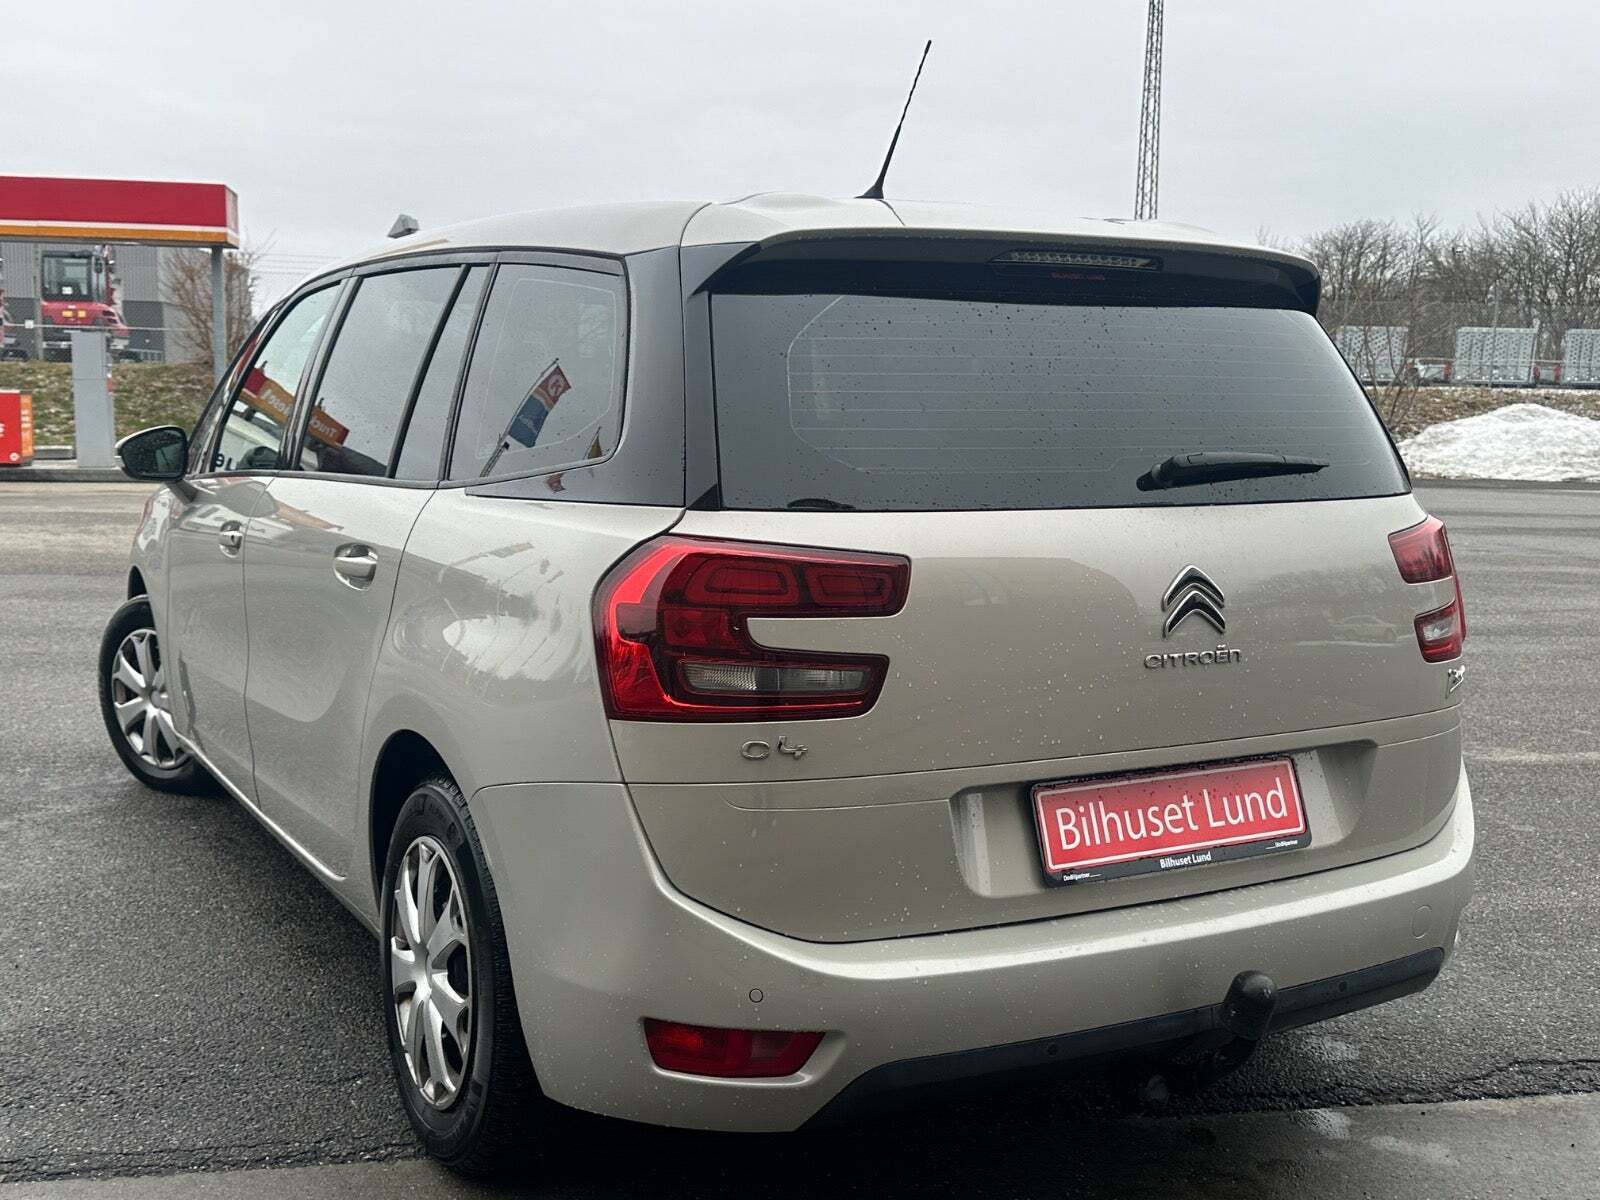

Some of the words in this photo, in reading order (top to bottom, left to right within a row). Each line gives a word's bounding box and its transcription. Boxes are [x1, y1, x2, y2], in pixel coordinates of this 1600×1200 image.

[740, 735, 808, 760] C4
[1055, 791, 1199, 851] Bilhuset
[1202, 777, 1288, 828] Lund
[1159, 854, 1192, 869] Bilhuset
[1191, 850, 1212, 864] Lund
